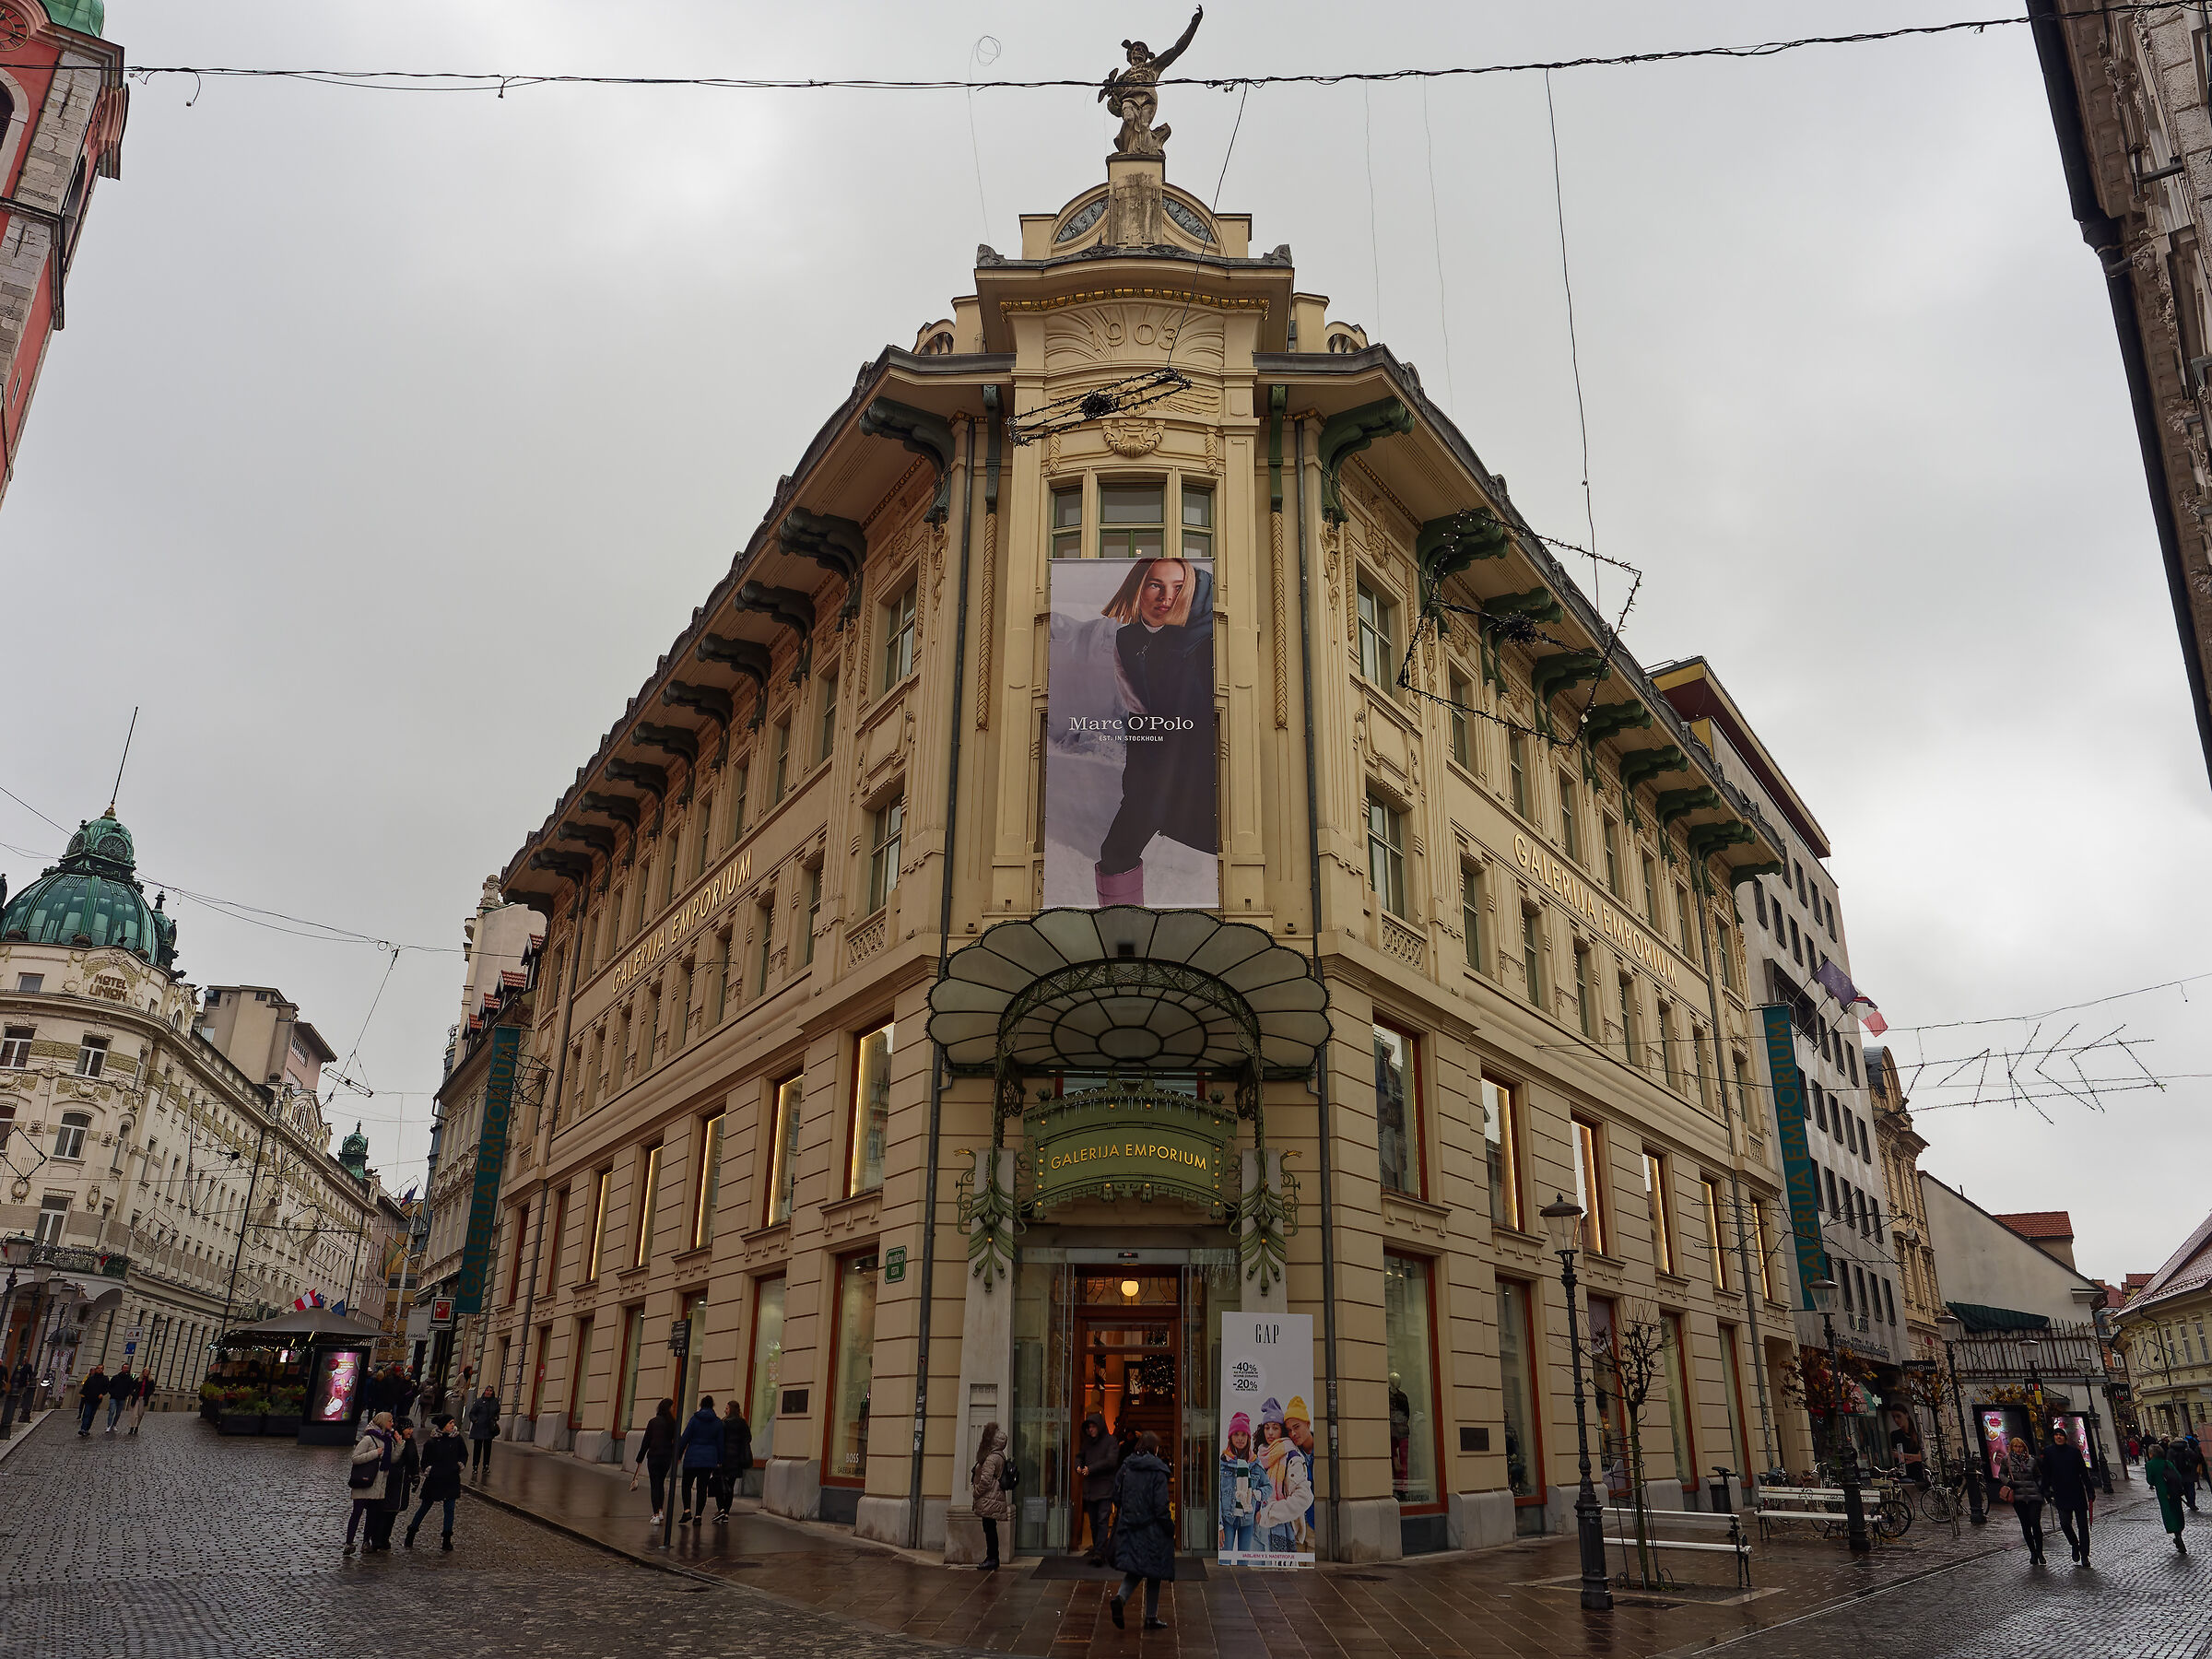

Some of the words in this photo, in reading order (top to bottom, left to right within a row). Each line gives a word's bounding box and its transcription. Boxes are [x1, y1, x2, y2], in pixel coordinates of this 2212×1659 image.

[1069, 715, 1123, 732] Marc
[1126, 715, 1194, 732] O'Polo
[1099, 735, 1113, 743] EST.
[1114, 735, 1123, 743] IN
[1124, 735, 1164, 743] STOCKHOLM
[1513, 833, 1597, 924] GALERIJA
[1601, 902, 1678, 987] EMPORIUM
[612, 927, 666, 994] GALERIJA
[670, 849, 752, 942] EMPORIUM
[94, 973, 126, 989] HOTEL
[88, 983, 127, 1001] UNION
[1769, 1019, 1807, 1162] EMPORIUM
[479, 1041, 517, 1174] EMPORIUM
[1051, 1144, 1120, 1171] GALERIJA
[1125, 1143, 1207, 1171] EMPORIUM
[461, 1177, 498, 1298] GALERIJA
[1790, 1169, 1823, 1291] GALERIJA
[1255, 1324, 1280, 1344] GAP
[1232, 1361, 1257, 1372] -40%
[1232, 1379, 1258, 1389] -20%
[845, 1453, 860, 1464] BOSS
